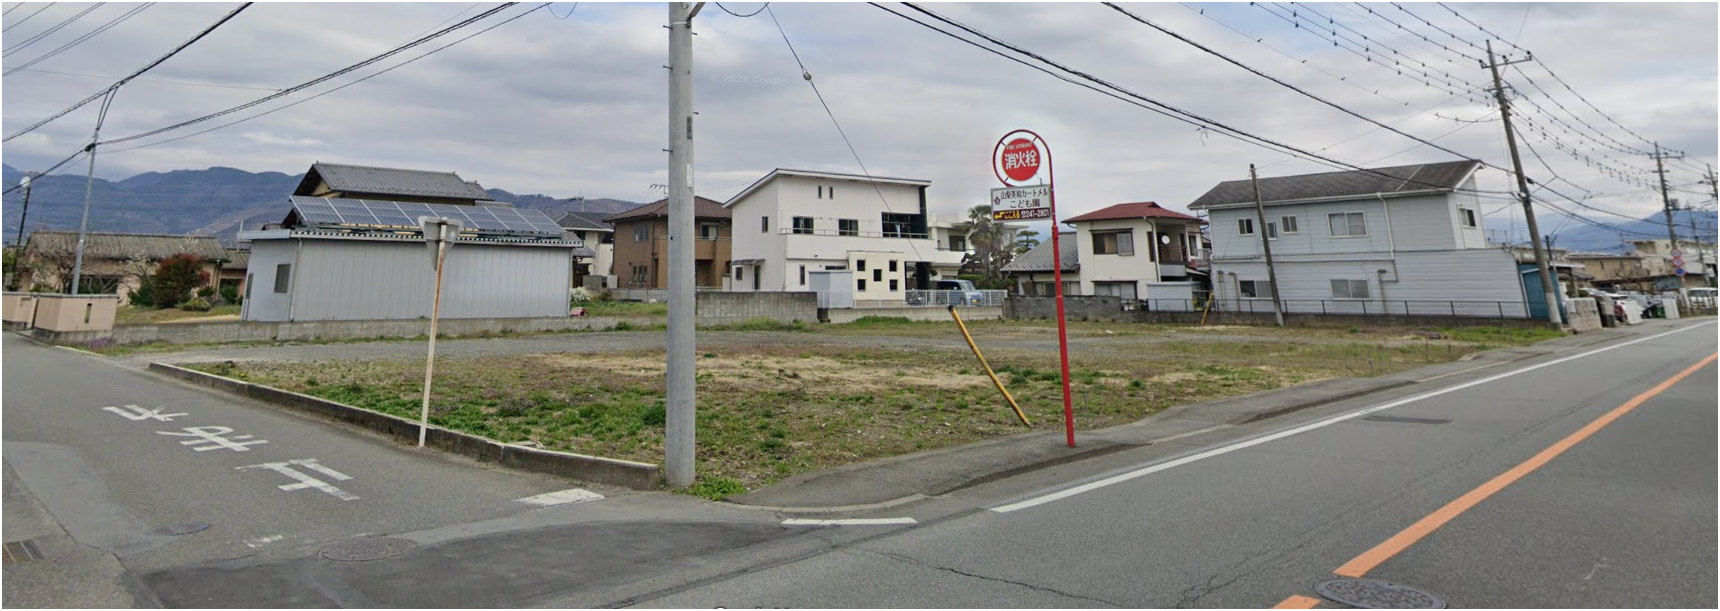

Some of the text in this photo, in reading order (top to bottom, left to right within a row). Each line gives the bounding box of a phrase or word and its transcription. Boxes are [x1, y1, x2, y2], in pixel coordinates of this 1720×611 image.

[1004, 150, 1038, 170] 消火栓
[1010, 199, 1040, 208] こども園
[1004, 210, 1020, 219] ここ入る
[102, 404, 361, 501] 止まれ
